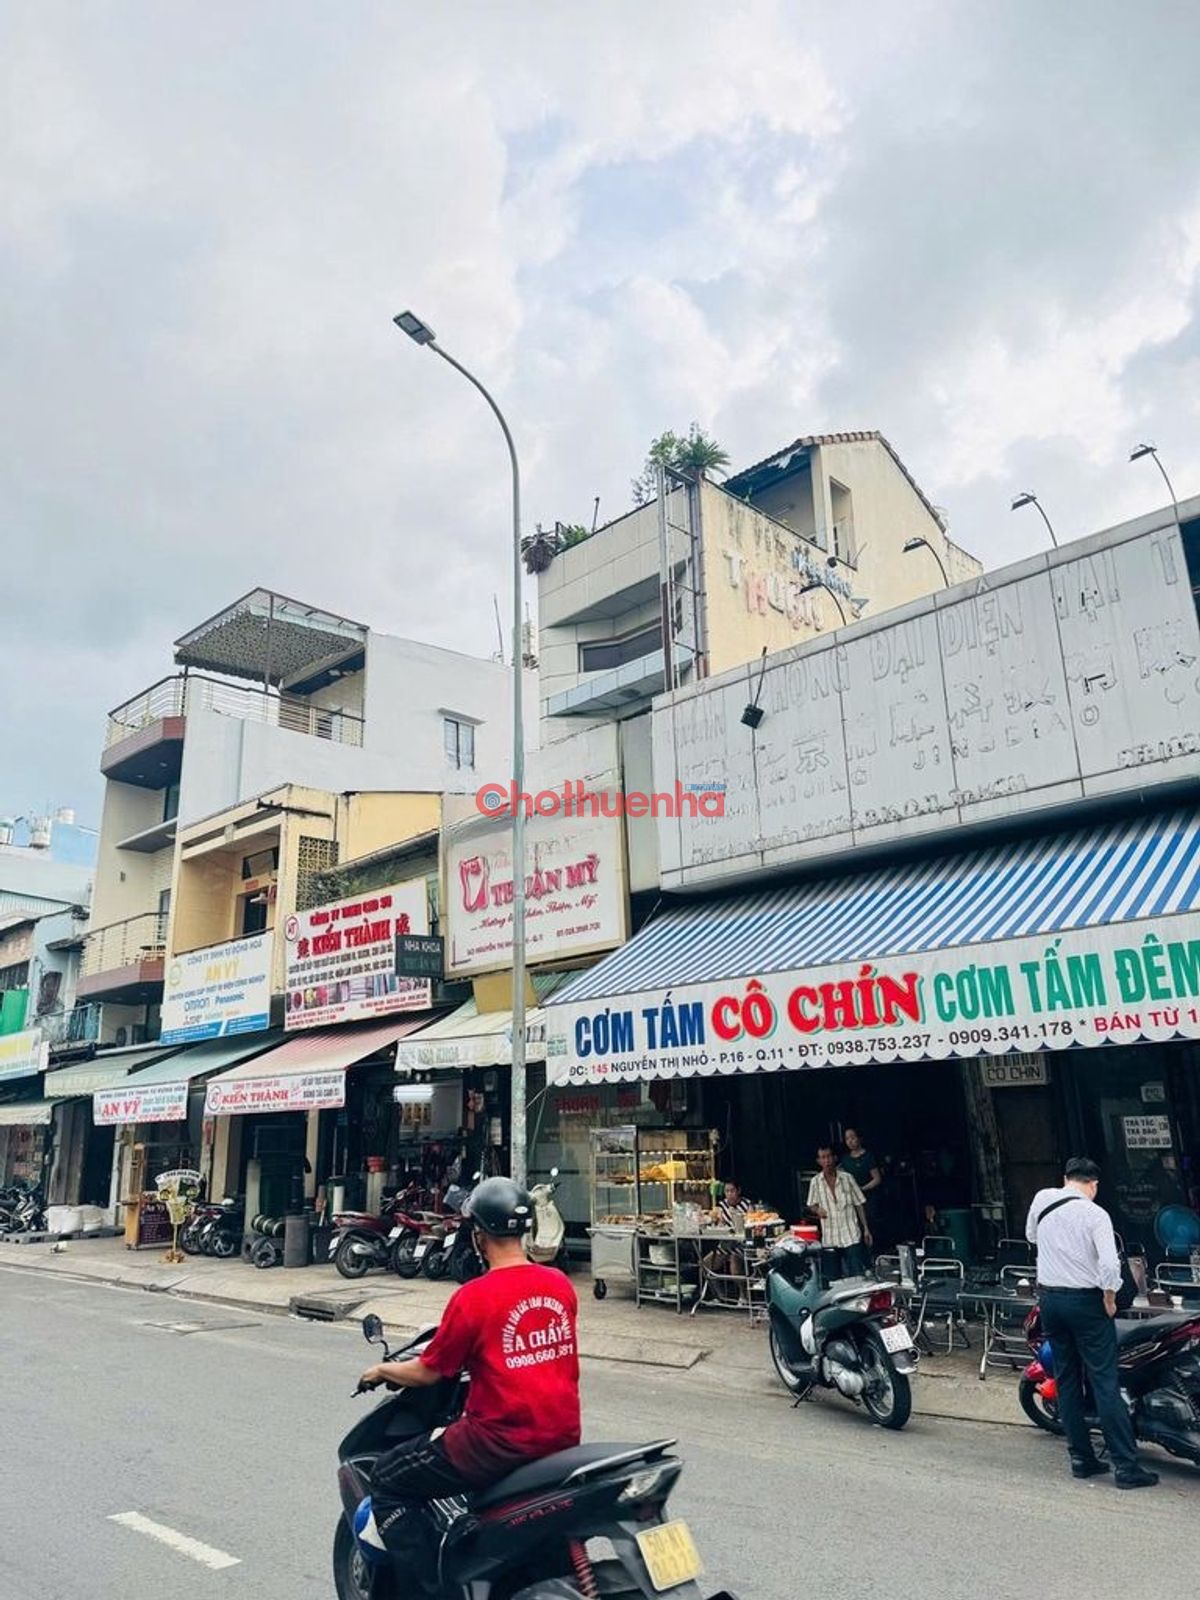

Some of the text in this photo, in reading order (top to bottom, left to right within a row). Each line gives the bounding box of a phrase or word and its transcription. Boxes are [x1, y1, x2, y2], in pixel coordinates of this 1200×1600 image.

[344, 917, 391, 948] THÀNH
[574, 933, 1200, 1058] CƠM TẤM CÔ CHÍN CƠM TẤM ĐÊM
[720, 1051, 744, 1063] P.16
[756, 1048, 783, 1061] Q.11
[799, 1043, 823, 1057] ĐT:
[827, 1034, 931, 1055] 0938.753.237
[949, 1021, 1073, 1045] 0909.341.178
[1094, 1011, 1141, 1032] BÁN
